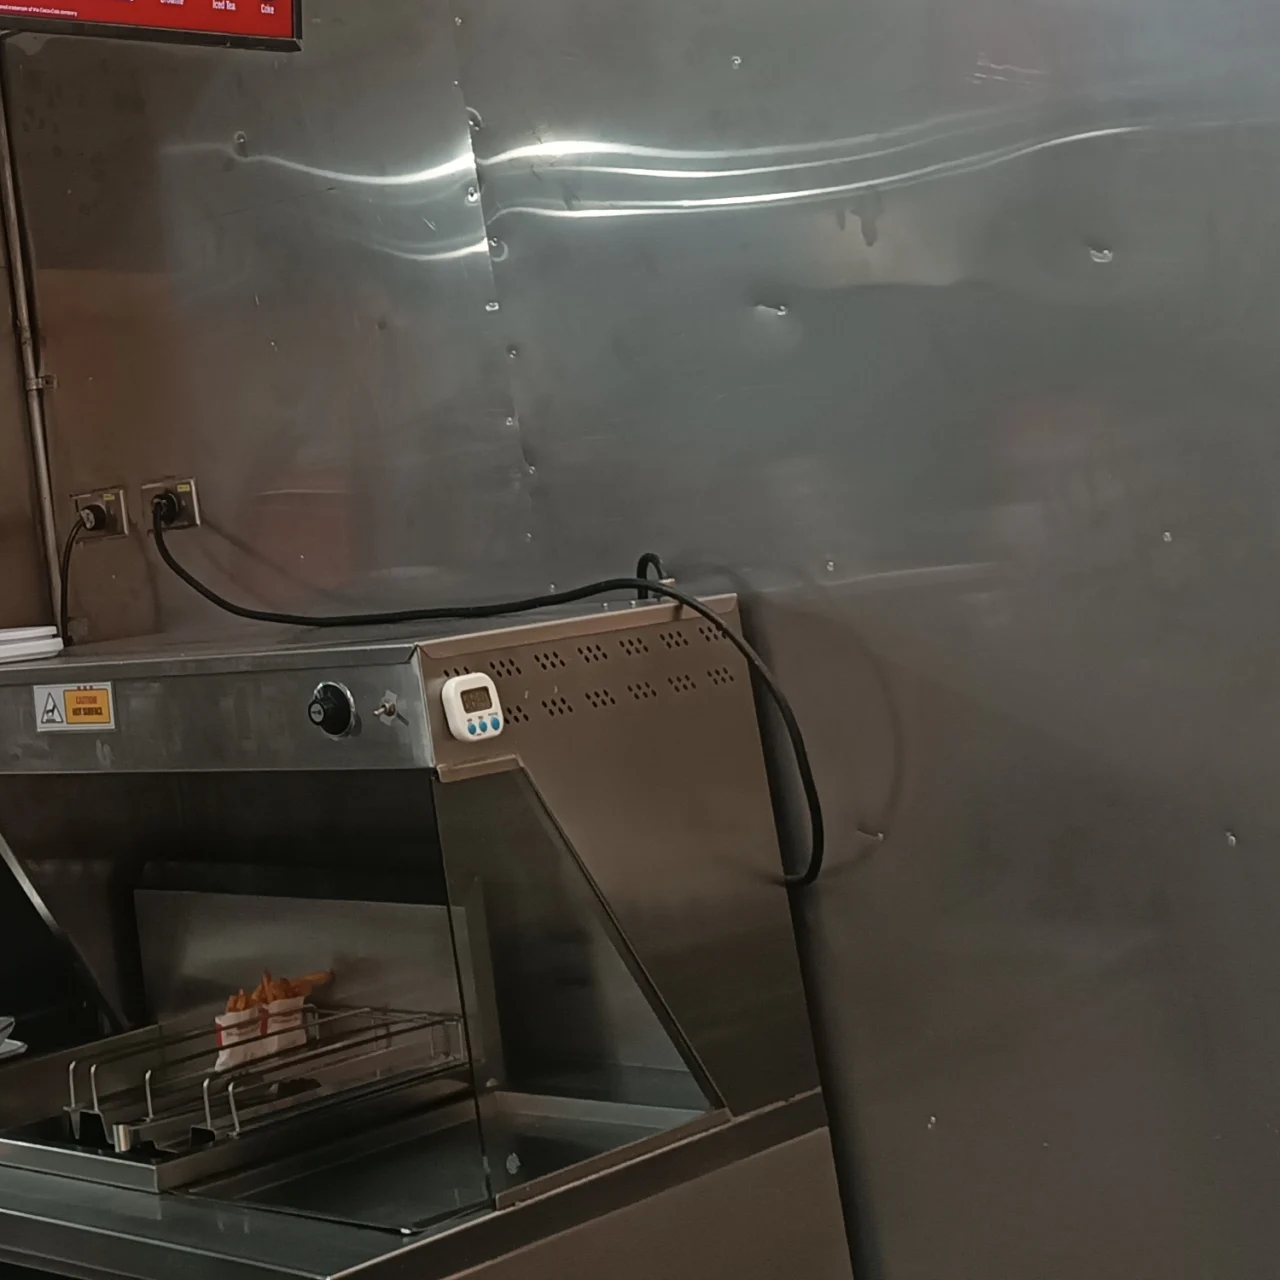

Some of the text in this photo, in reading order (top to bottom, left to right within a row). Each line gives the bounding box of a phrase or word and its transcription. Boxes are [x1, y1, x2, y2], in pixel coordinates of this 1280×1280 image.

[212, 0, 236, 11] Iced Tea
[261, 4, 274, 14] Coke
